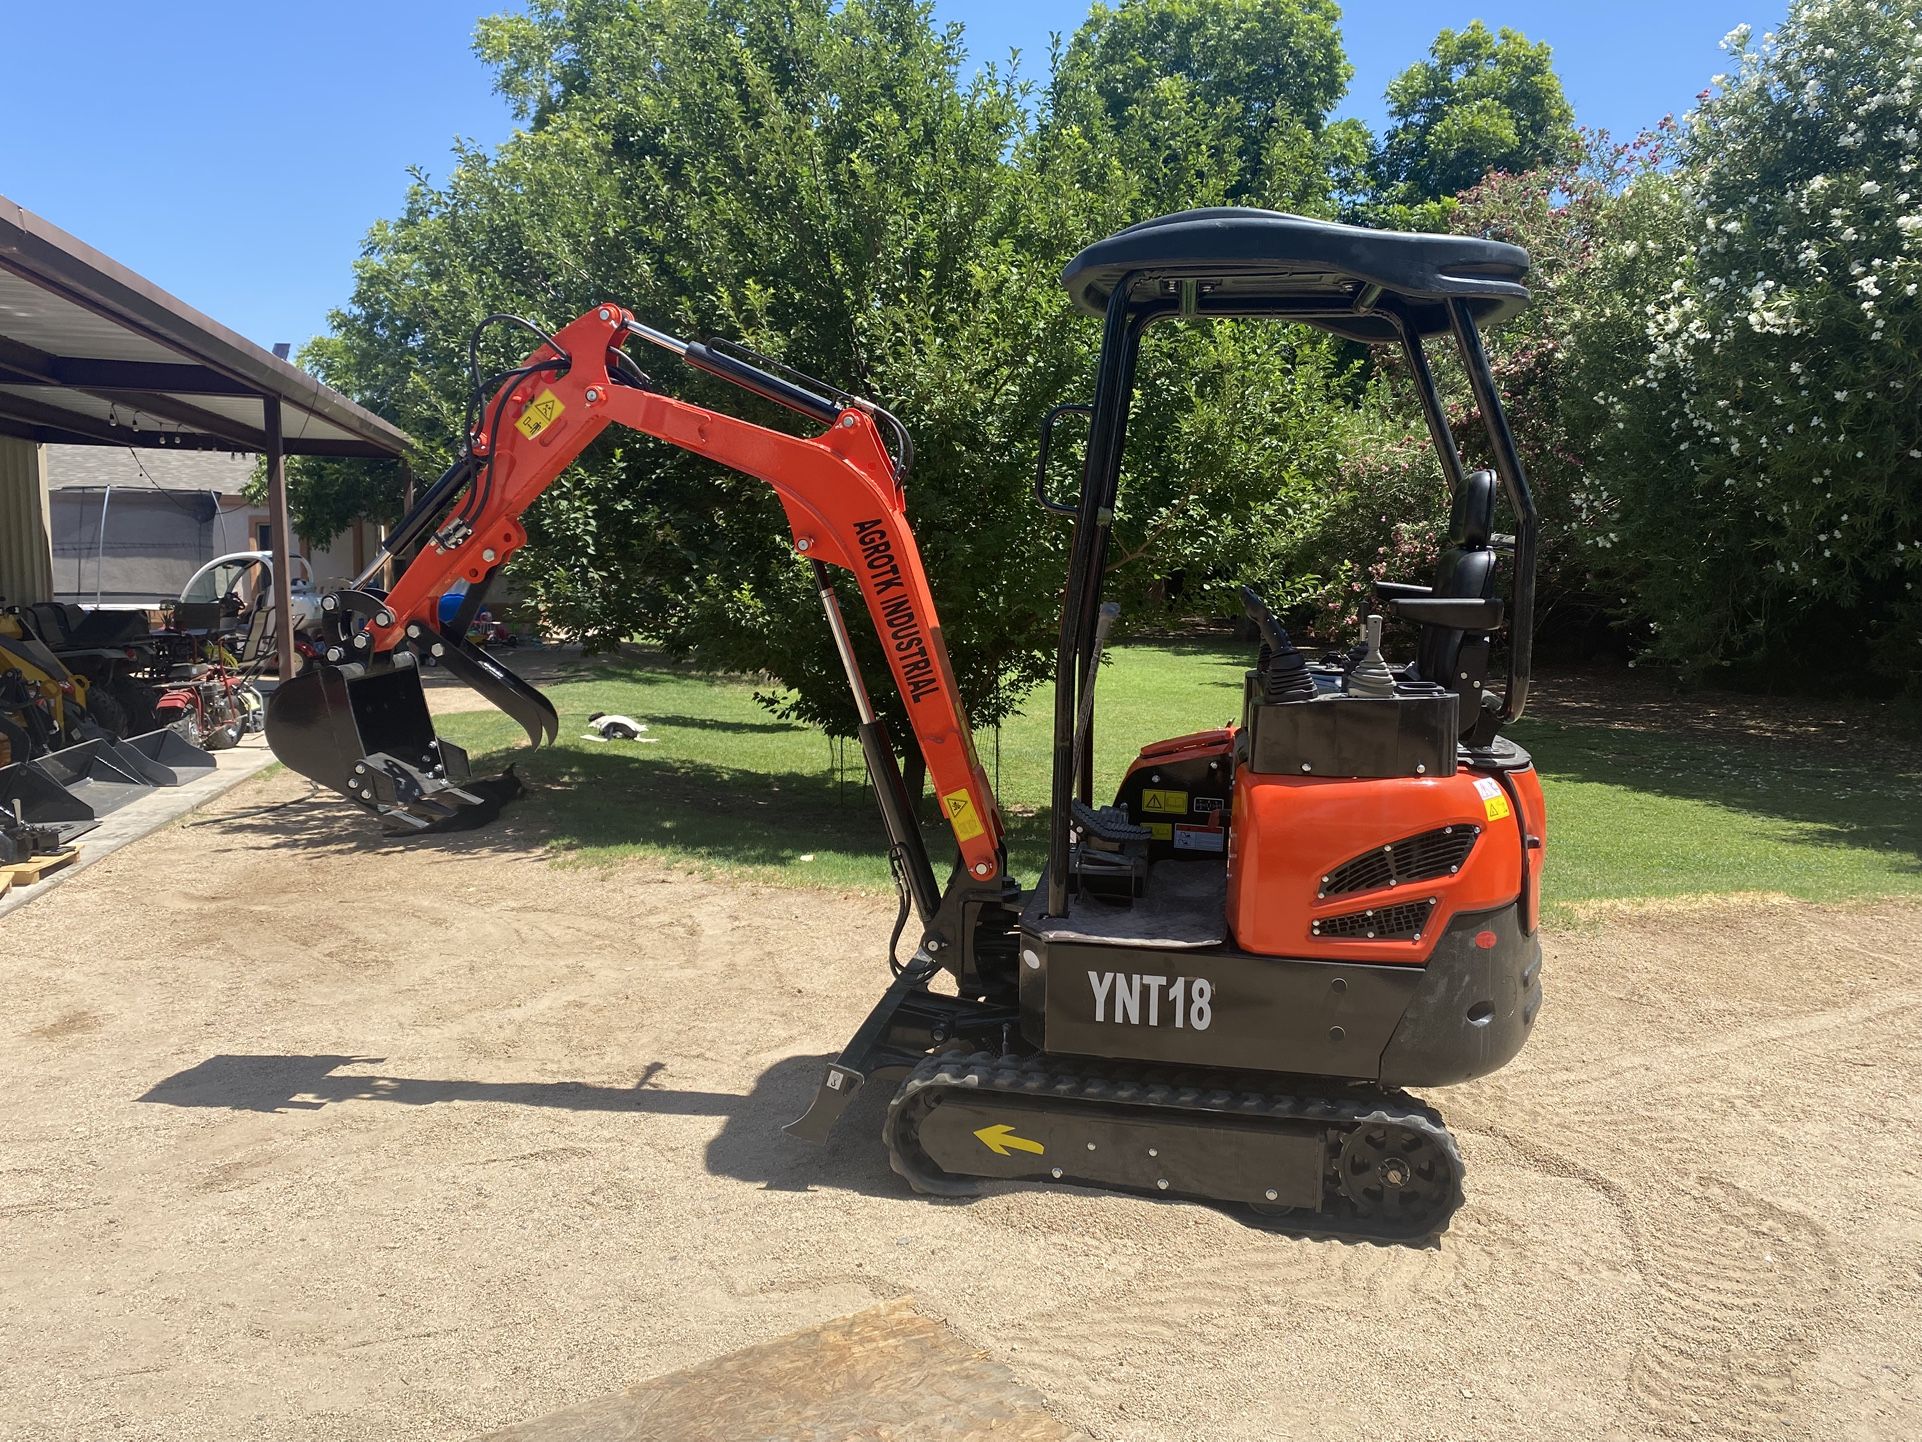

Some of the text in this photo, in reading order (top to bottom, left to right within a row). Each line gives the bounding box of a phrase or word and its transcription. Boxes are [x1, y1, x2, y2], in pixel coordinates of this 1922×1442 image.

[853, 518, 940, 704] AGROTK INDUSTRIAL
[1087, 970, 1212, 1031] YNT18
